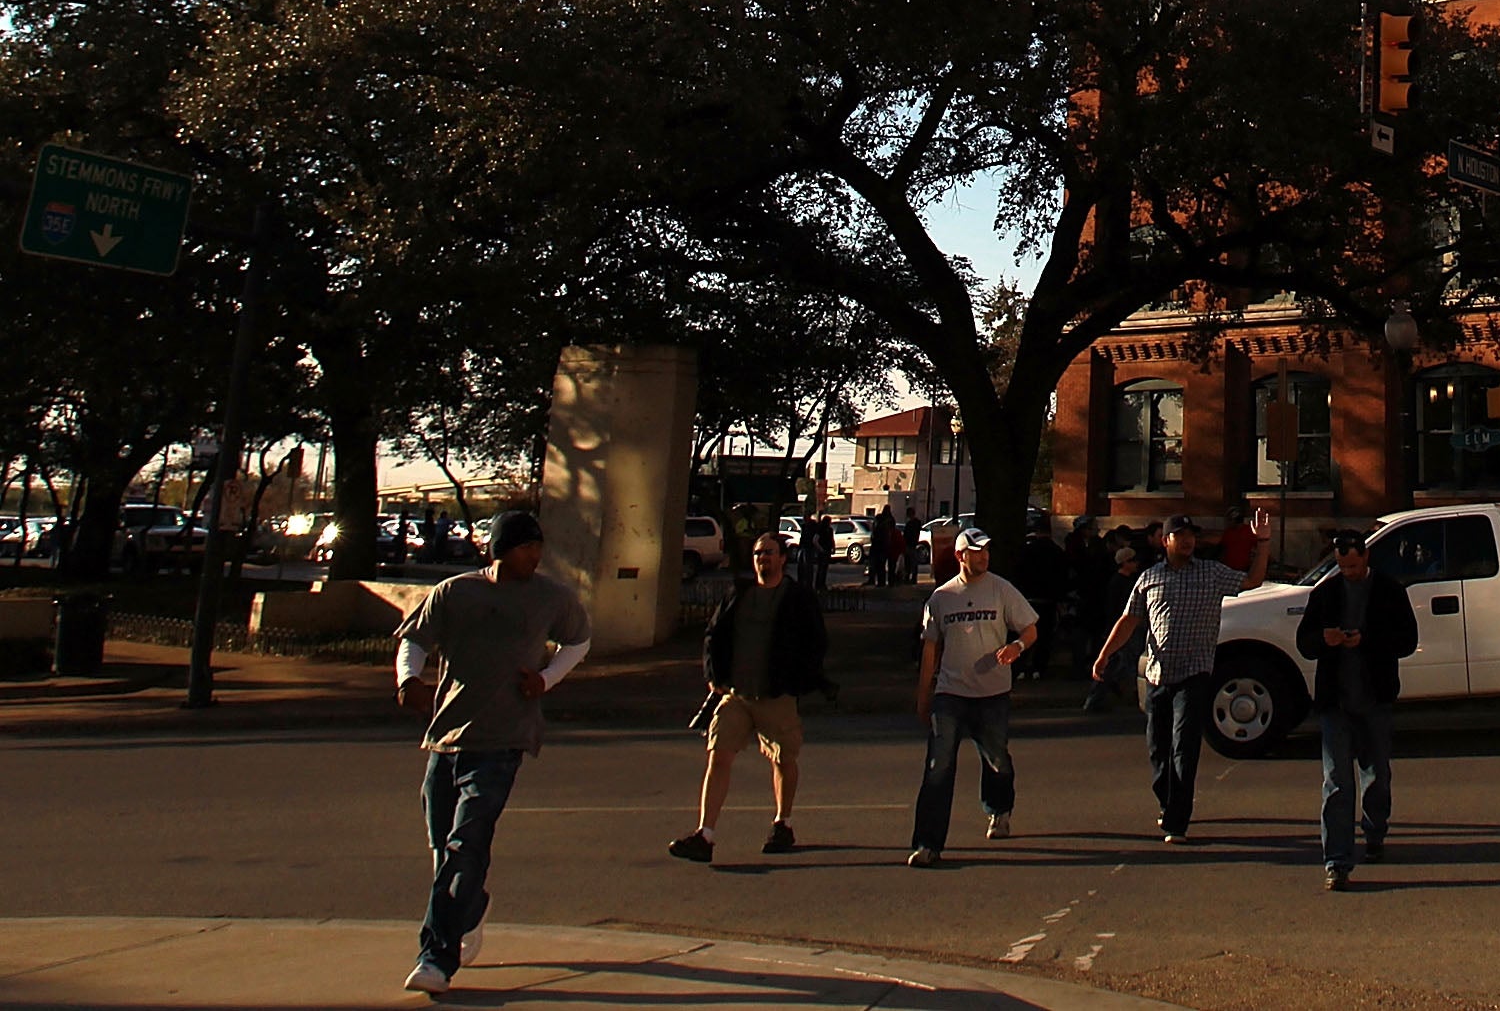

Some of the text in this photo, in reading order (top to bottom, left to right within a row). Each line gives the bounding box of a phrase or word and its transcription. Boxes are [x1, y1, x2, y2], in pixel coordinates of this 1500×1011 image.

[46, 154, 186, 202] STEMMONS FRWY
[1465, 156, 1500, 186] HOUSTON
[84, 191, 142, 221] NORTH
[42, 215, 72, 235] 35E
[1464, 433, 1491, 446] ELM
[943, 610, 997, 625] COWBOYS
